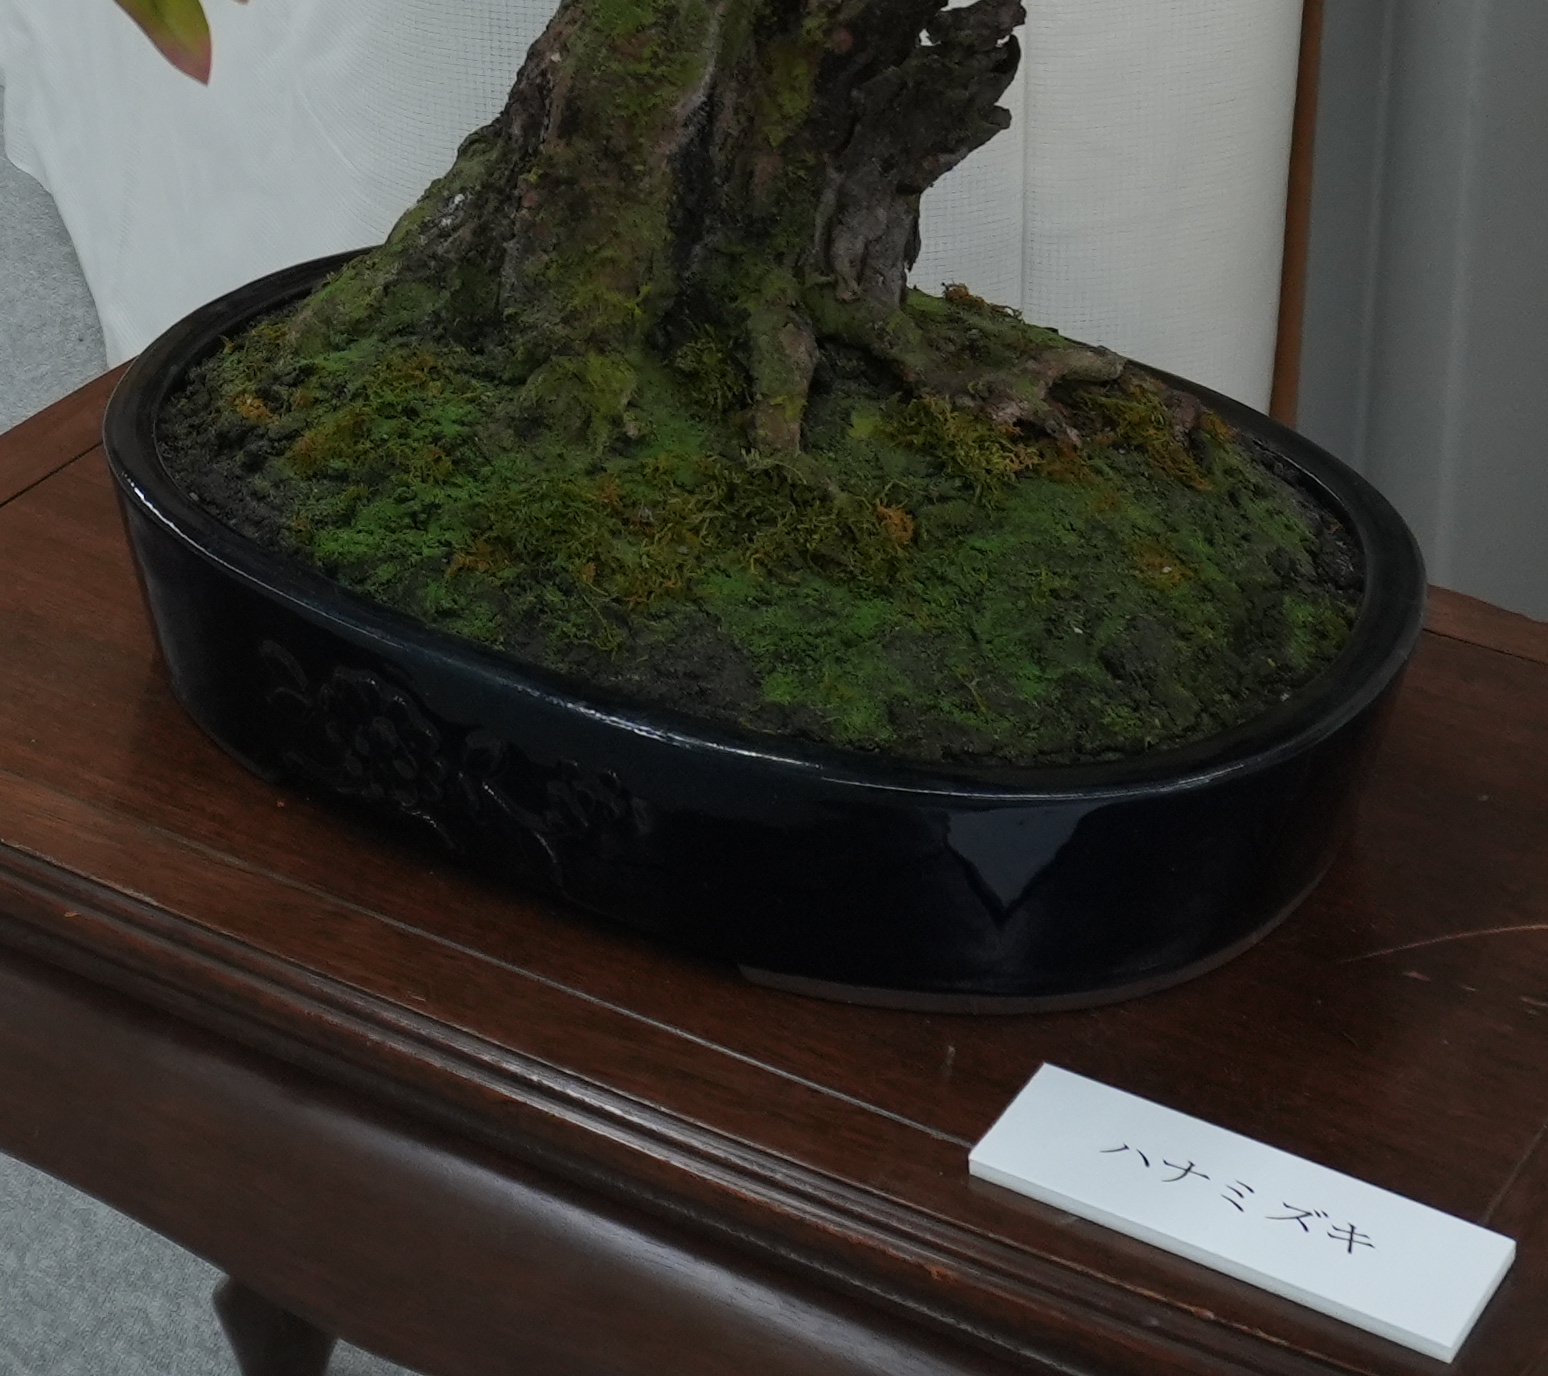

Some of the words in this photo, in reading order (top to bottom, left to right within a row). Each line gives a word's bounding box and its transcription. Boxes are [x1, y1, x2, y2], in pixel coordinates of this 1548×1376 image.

[1099, 1143, 1376, 1254] ハナミズキ
